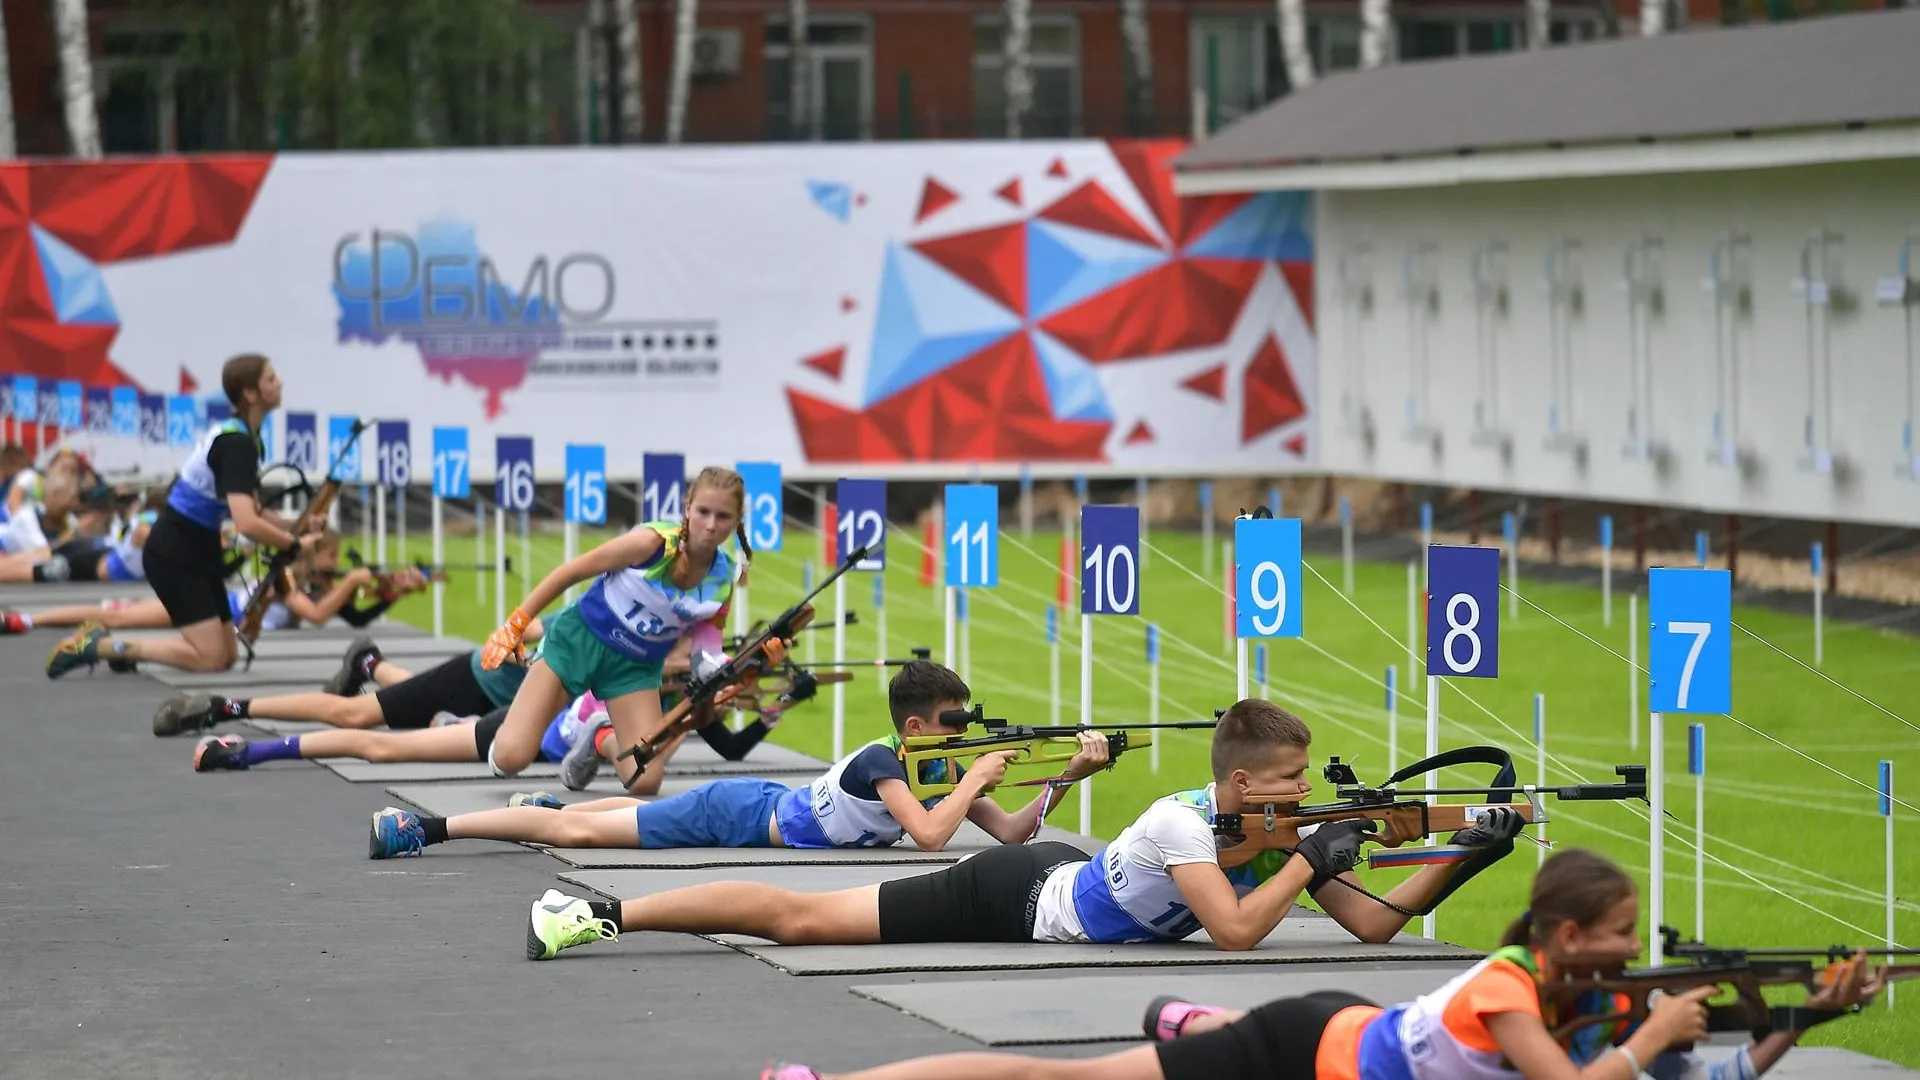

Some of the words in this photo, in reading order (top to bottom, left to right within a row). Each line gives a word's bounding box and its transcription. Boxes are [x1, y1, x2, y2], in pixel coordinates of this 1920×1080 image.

[333, 226, 616, 334] ФБМО
[141, 406, 166, 443] 24
[169, 410, 194, 445] 23
[286, 429, 316, 471] 20
[379, 442, 410, 487] 18
[433, 450, 467, 495] 17
[497, 459, 535, 510] 16
[565, 470, 604, 522] 15
[645, 480, 683, 522] 14
[839, 509, 883, 569] 12
[951, 520, 989, 585] 11
[1084, 543, 1136, 613] 10
[1250, 561, 1287, 636] 9
[1443, 592, 1482, 674] 8
[1668, 621, 1711, 709] 7
[1029, 879, 1044, 902] PRO
[1110, 851, 1123, 884] 169
